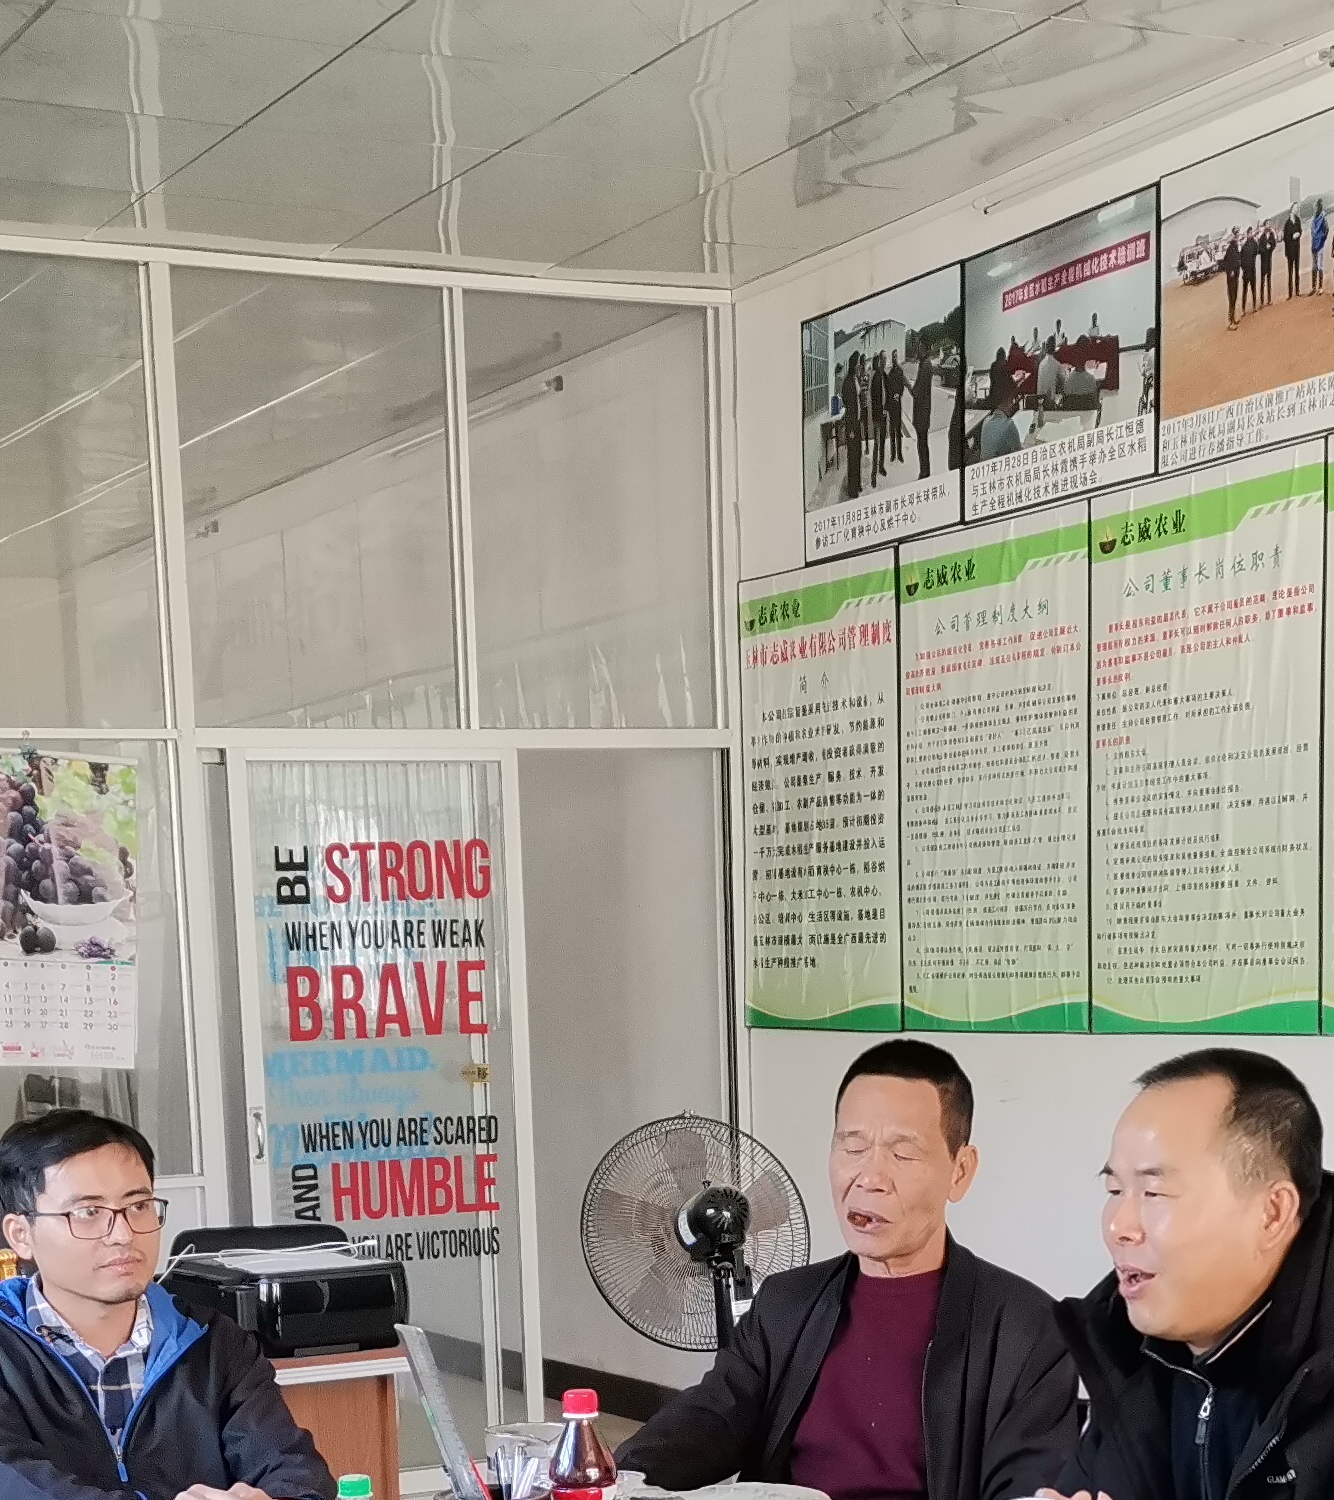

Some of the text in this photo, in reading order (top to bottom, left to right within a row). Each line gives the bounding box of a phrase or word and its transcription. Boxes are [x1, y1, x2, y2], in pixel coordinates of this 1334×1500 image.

[1121, 509, 1186, 546] 志威农业
[923, 562, 975, 590] 志威农业
[1123, 544, 1282, 598] 公司董事长岗位职责
[274, 845, 311, 905] BE
[325, 838, 491, 905] STRONG
[285, 918, 486, 952] WHEN YOU ARE WEAK
[84, 1010, 93, 1018] 22
[286, 960, 489, 1041] BRAVE
[84, 1022, 93, 1030] 29
[301, 1121, 355, 1153] WHEN
[358, 1119, 391, 1150] YOU
[396, 1117, 428, 1146] ARE
[433, 1115, 498, 1146] SCARED
[291, 1163, 321, 1222] AND
[331, 1153, 500, 1222] HUMBLE
[386, 1231, 414, 1261] ARE
[418, 1226, 500, 1259] VICTORIOUS
